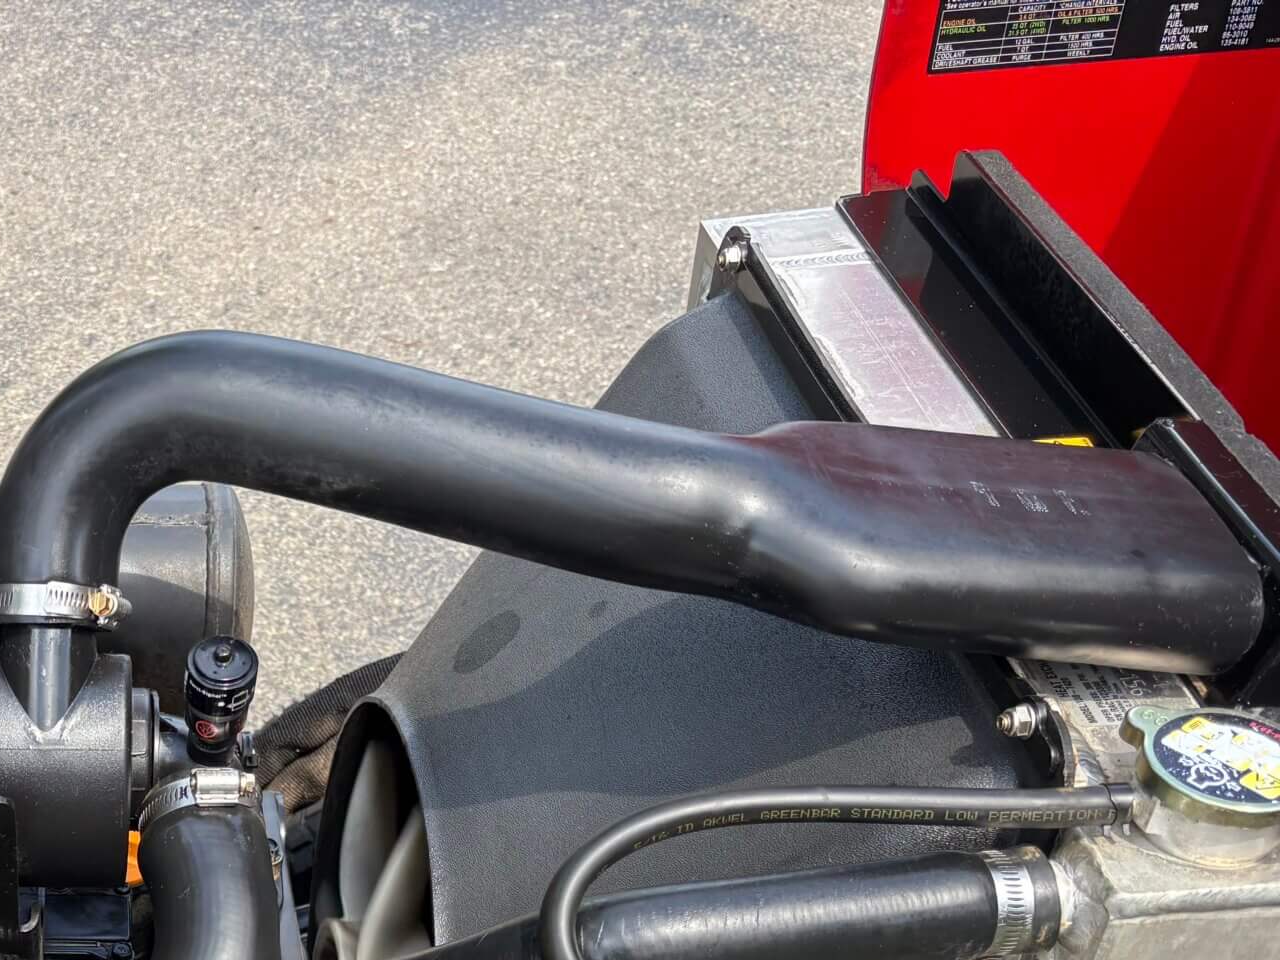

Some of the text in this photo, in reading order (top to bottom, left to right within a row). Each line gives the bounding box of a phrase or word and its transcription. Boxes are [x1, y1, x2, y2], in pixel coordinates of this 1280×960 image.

[1170, 3, 1199, 11] FILTERS
[943, 19, 966, 27] ENGINE
[941, 27, 976, 36] HYDRAULIC
[1164, 25, 1209, 35] FUEL/WATER
[1159, 43, 1185, 51] ENGINE
[937, 51, 966, 59] COOLANT
[935, 56, 998, 67] DRIVESHAFT GREASE
[760, 808, 841, 820] GREENBAR
[851, 808, 935, 820] STANDARD
[944, 810, 978, 821] LOW
